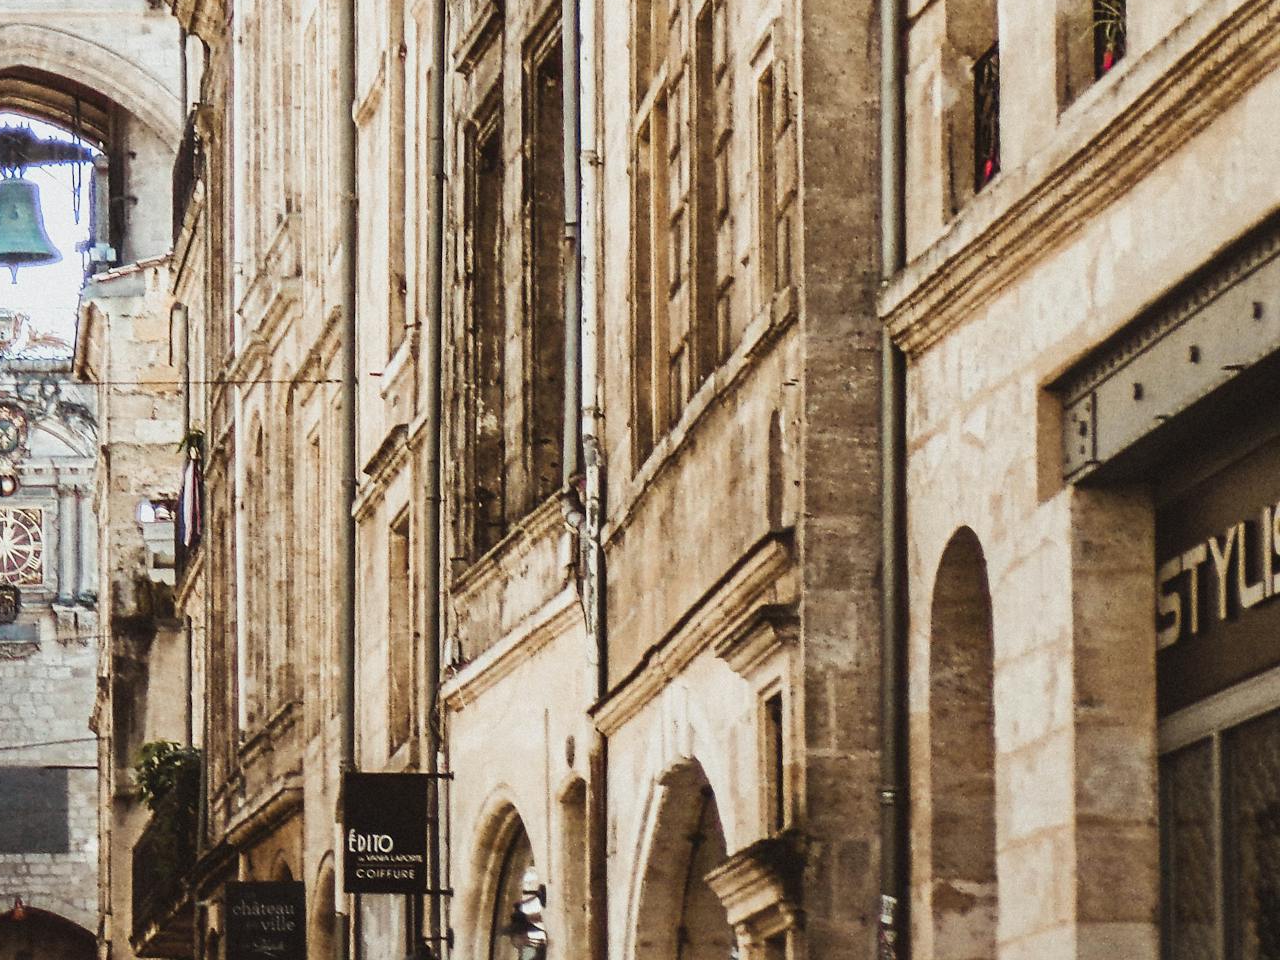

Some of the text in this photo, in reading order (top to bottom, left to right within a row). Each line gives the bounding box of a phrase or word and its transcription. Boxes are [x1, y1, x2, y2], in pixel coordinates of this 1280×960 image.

[348, 828, 394, 853] ÉDITO
[356, 868, 415, 879] COIFFURE
[232, 898, 295, 916] château
[260, 915, 297, 932] ville
